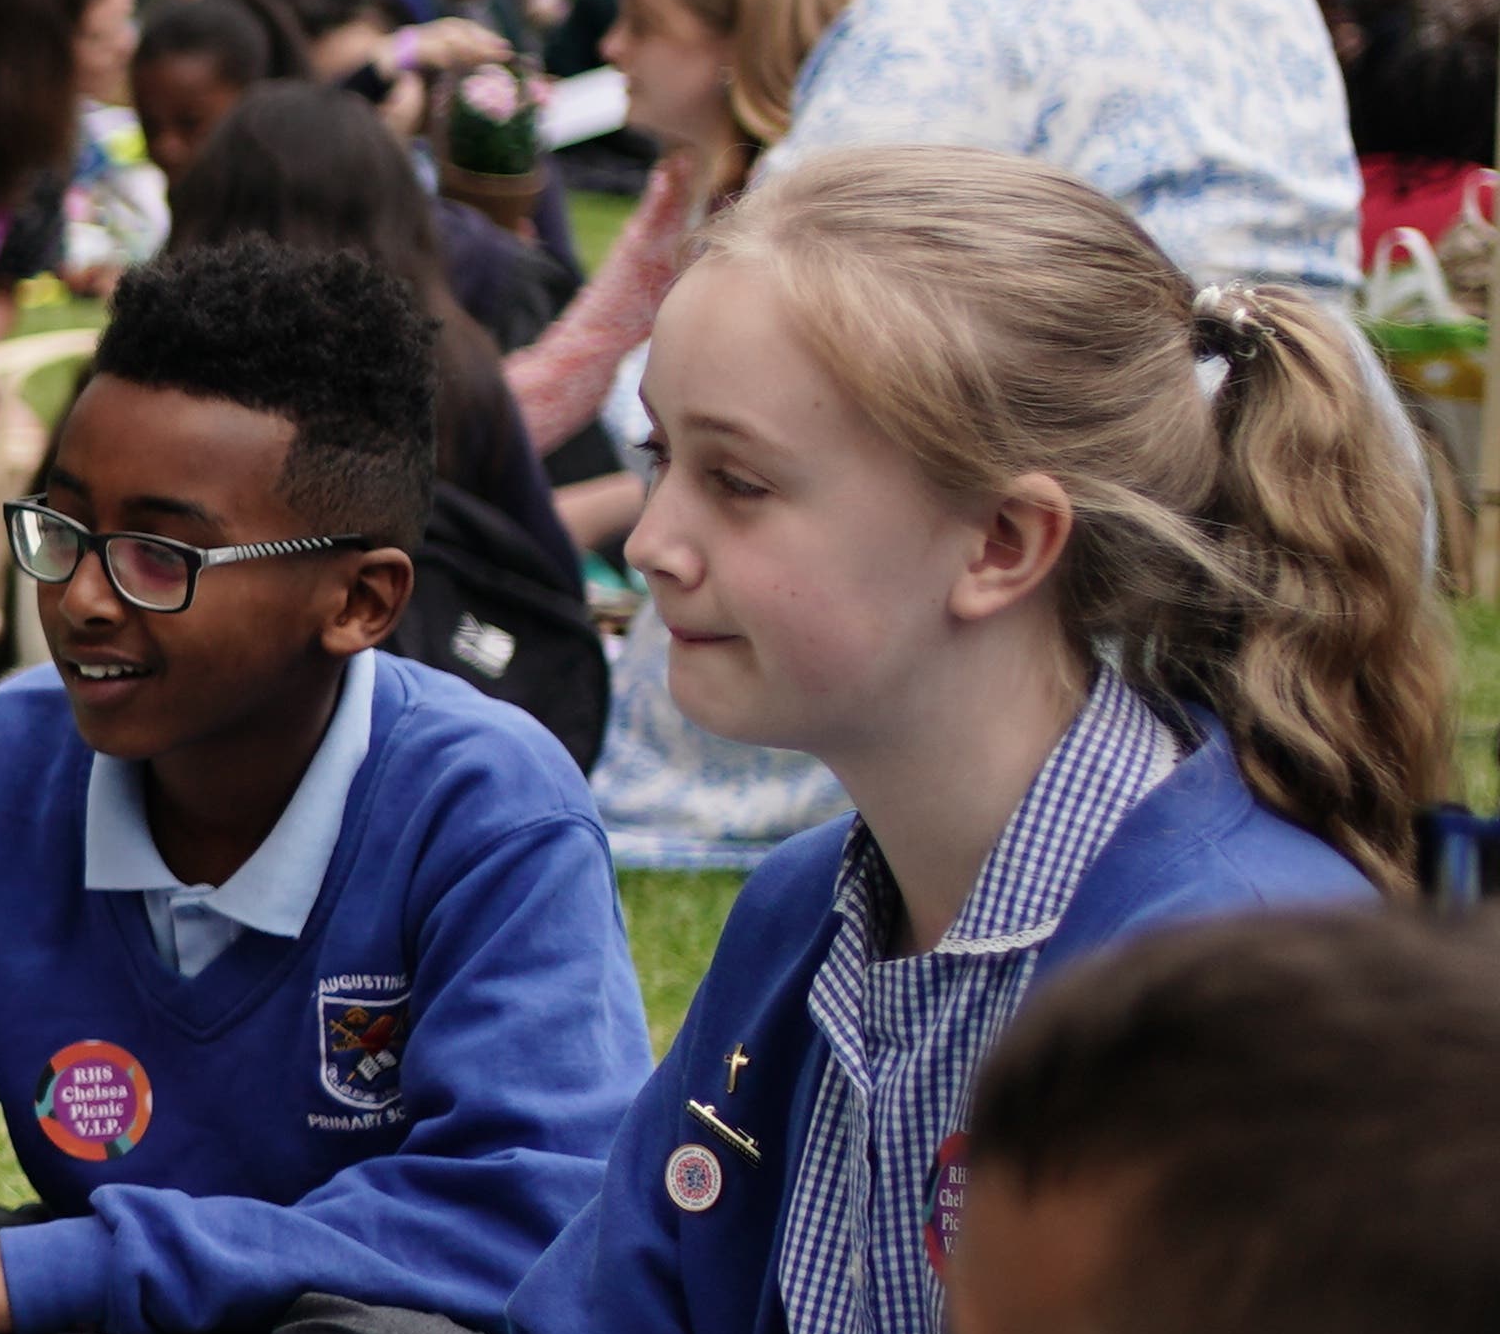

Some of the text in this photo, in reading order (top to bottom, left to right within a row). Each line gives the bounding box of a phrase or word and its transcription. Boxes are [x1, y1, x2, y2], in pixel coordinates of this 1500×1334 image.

[73, 1065, 114, 1084] RHS
[61, 1084, 128, 1103] Chelsea
[70, 1100, 125, 1120] Picnic
[75, 1118, 122, 1136] V.I.P.
[307, 1111, 383, 1131] PRIMARY
[948, 1165, 970, 1184] RH
